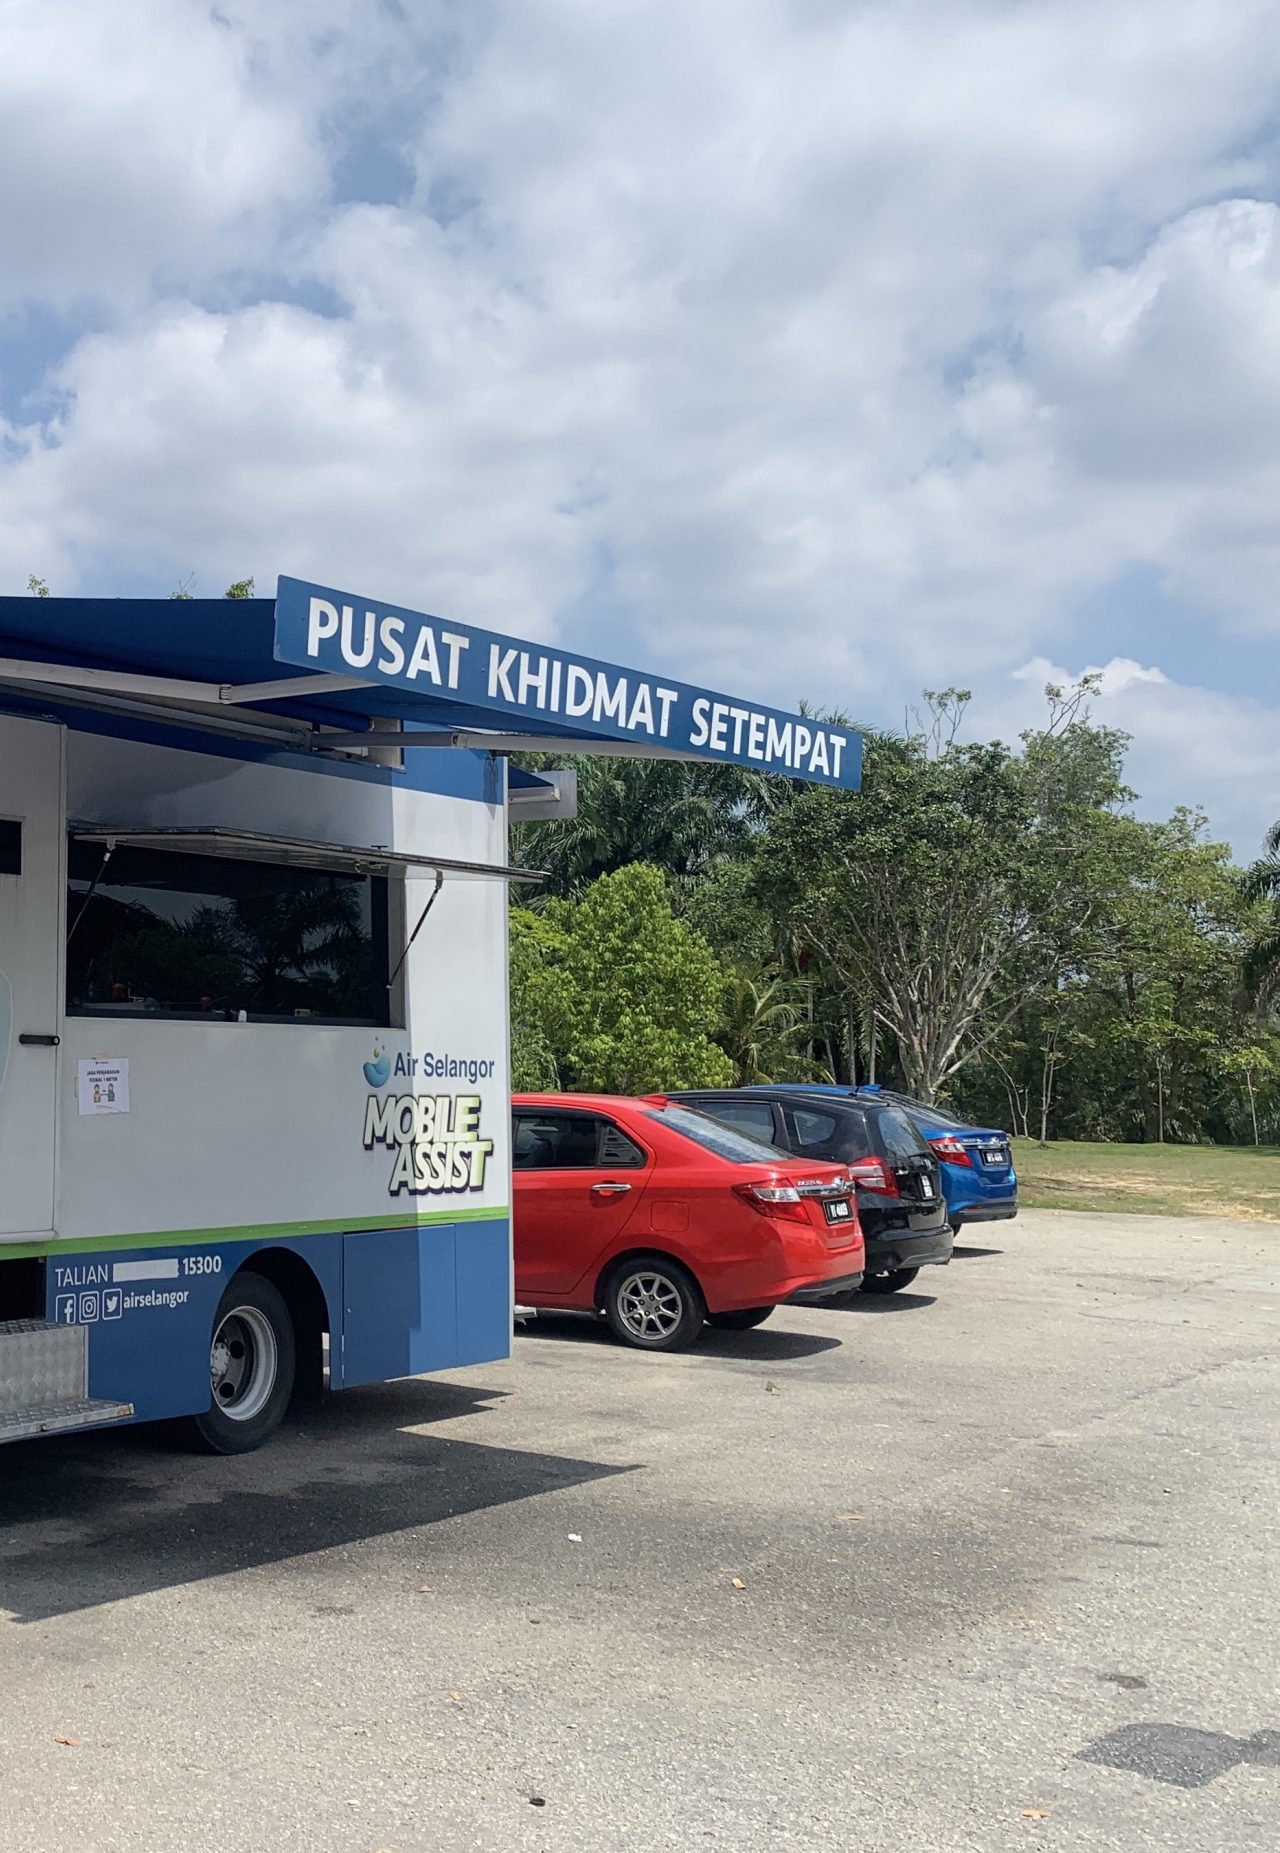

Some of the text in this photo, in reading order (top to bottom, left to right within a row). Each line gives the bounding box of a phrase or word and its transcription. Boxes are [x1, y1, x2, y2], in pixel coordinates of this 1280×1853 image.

[307, 597, 846, 779] PUSAT KHIDMAT SETEMPAT
[394, 1052, 495, 1084] Air Selangor
[363, 1095, 481, 1150] MOBILE
[388, 1139, 494, 1196] ASSIST
[55, 1255, 222, 1288] TALIAN 15300
[123, 1290, 189, 1309] airselangor
